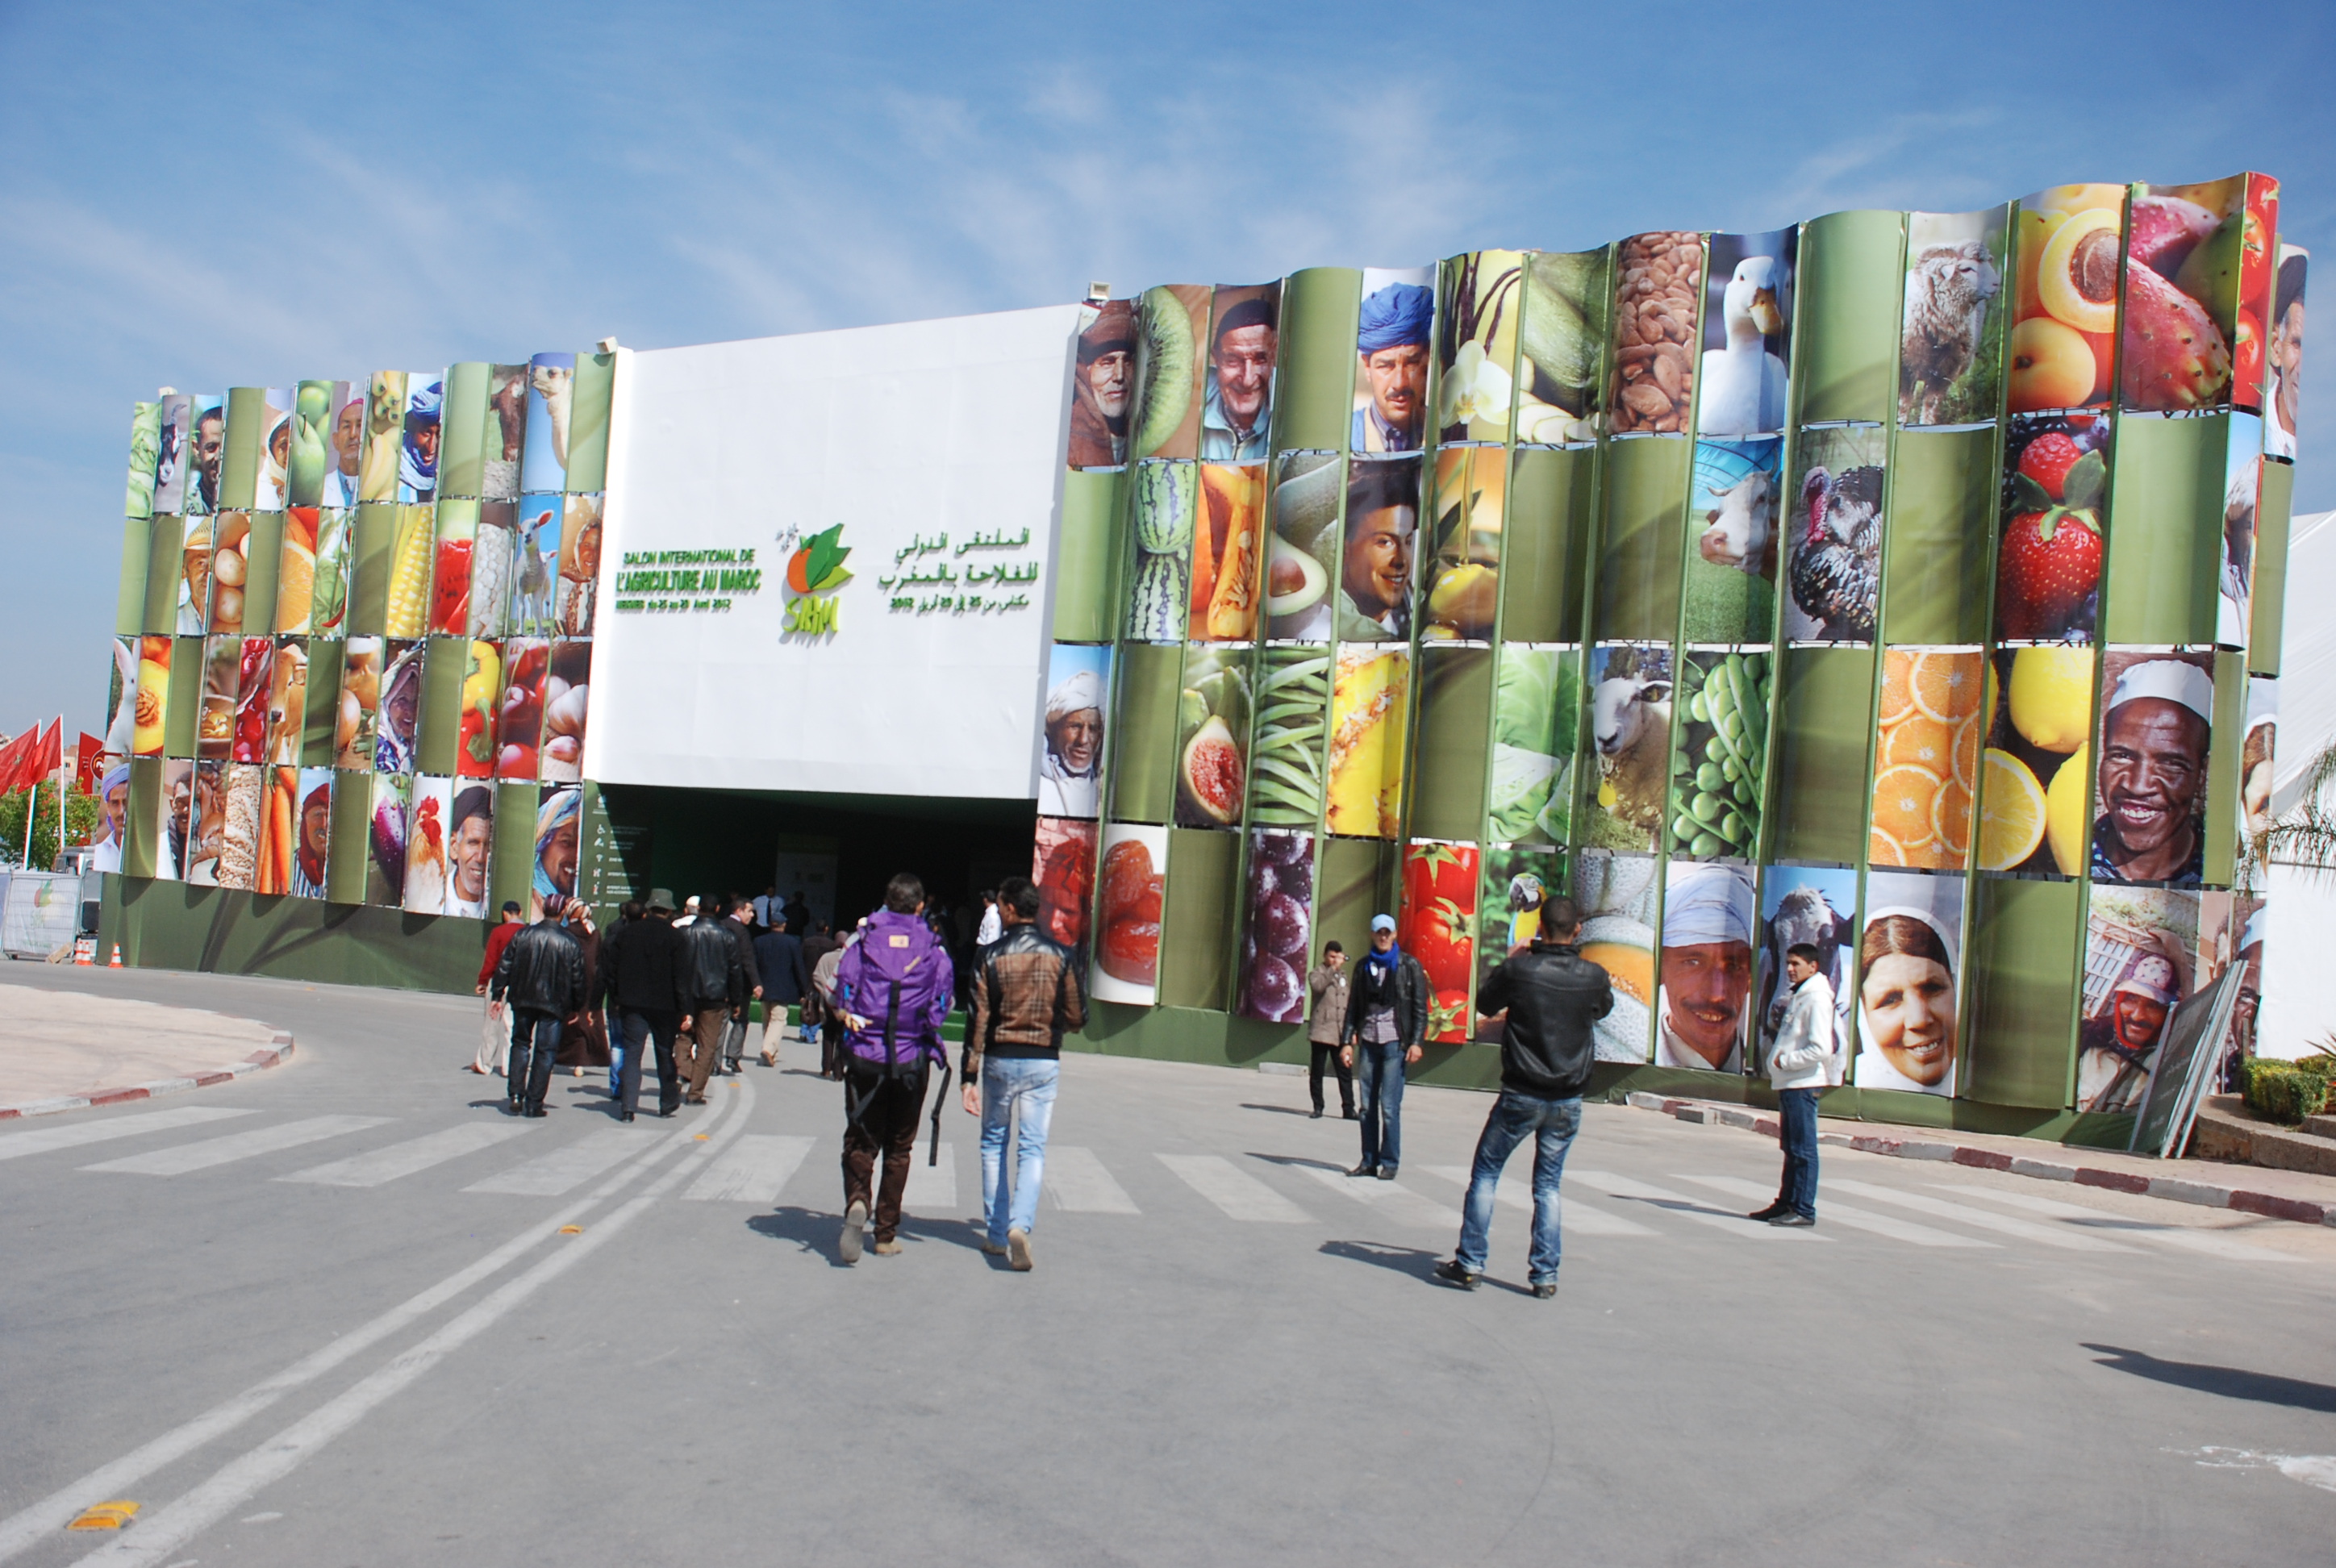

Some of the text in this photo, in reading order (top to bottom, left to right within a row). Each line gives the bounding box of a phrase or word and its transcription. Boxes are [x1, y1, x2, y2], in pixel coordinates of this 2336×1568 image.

[624, 548, 756, 565] SALON INTERNATIONAL DE
[616, 569, 762, 592] L'AGRICULTURE AU MAROC
